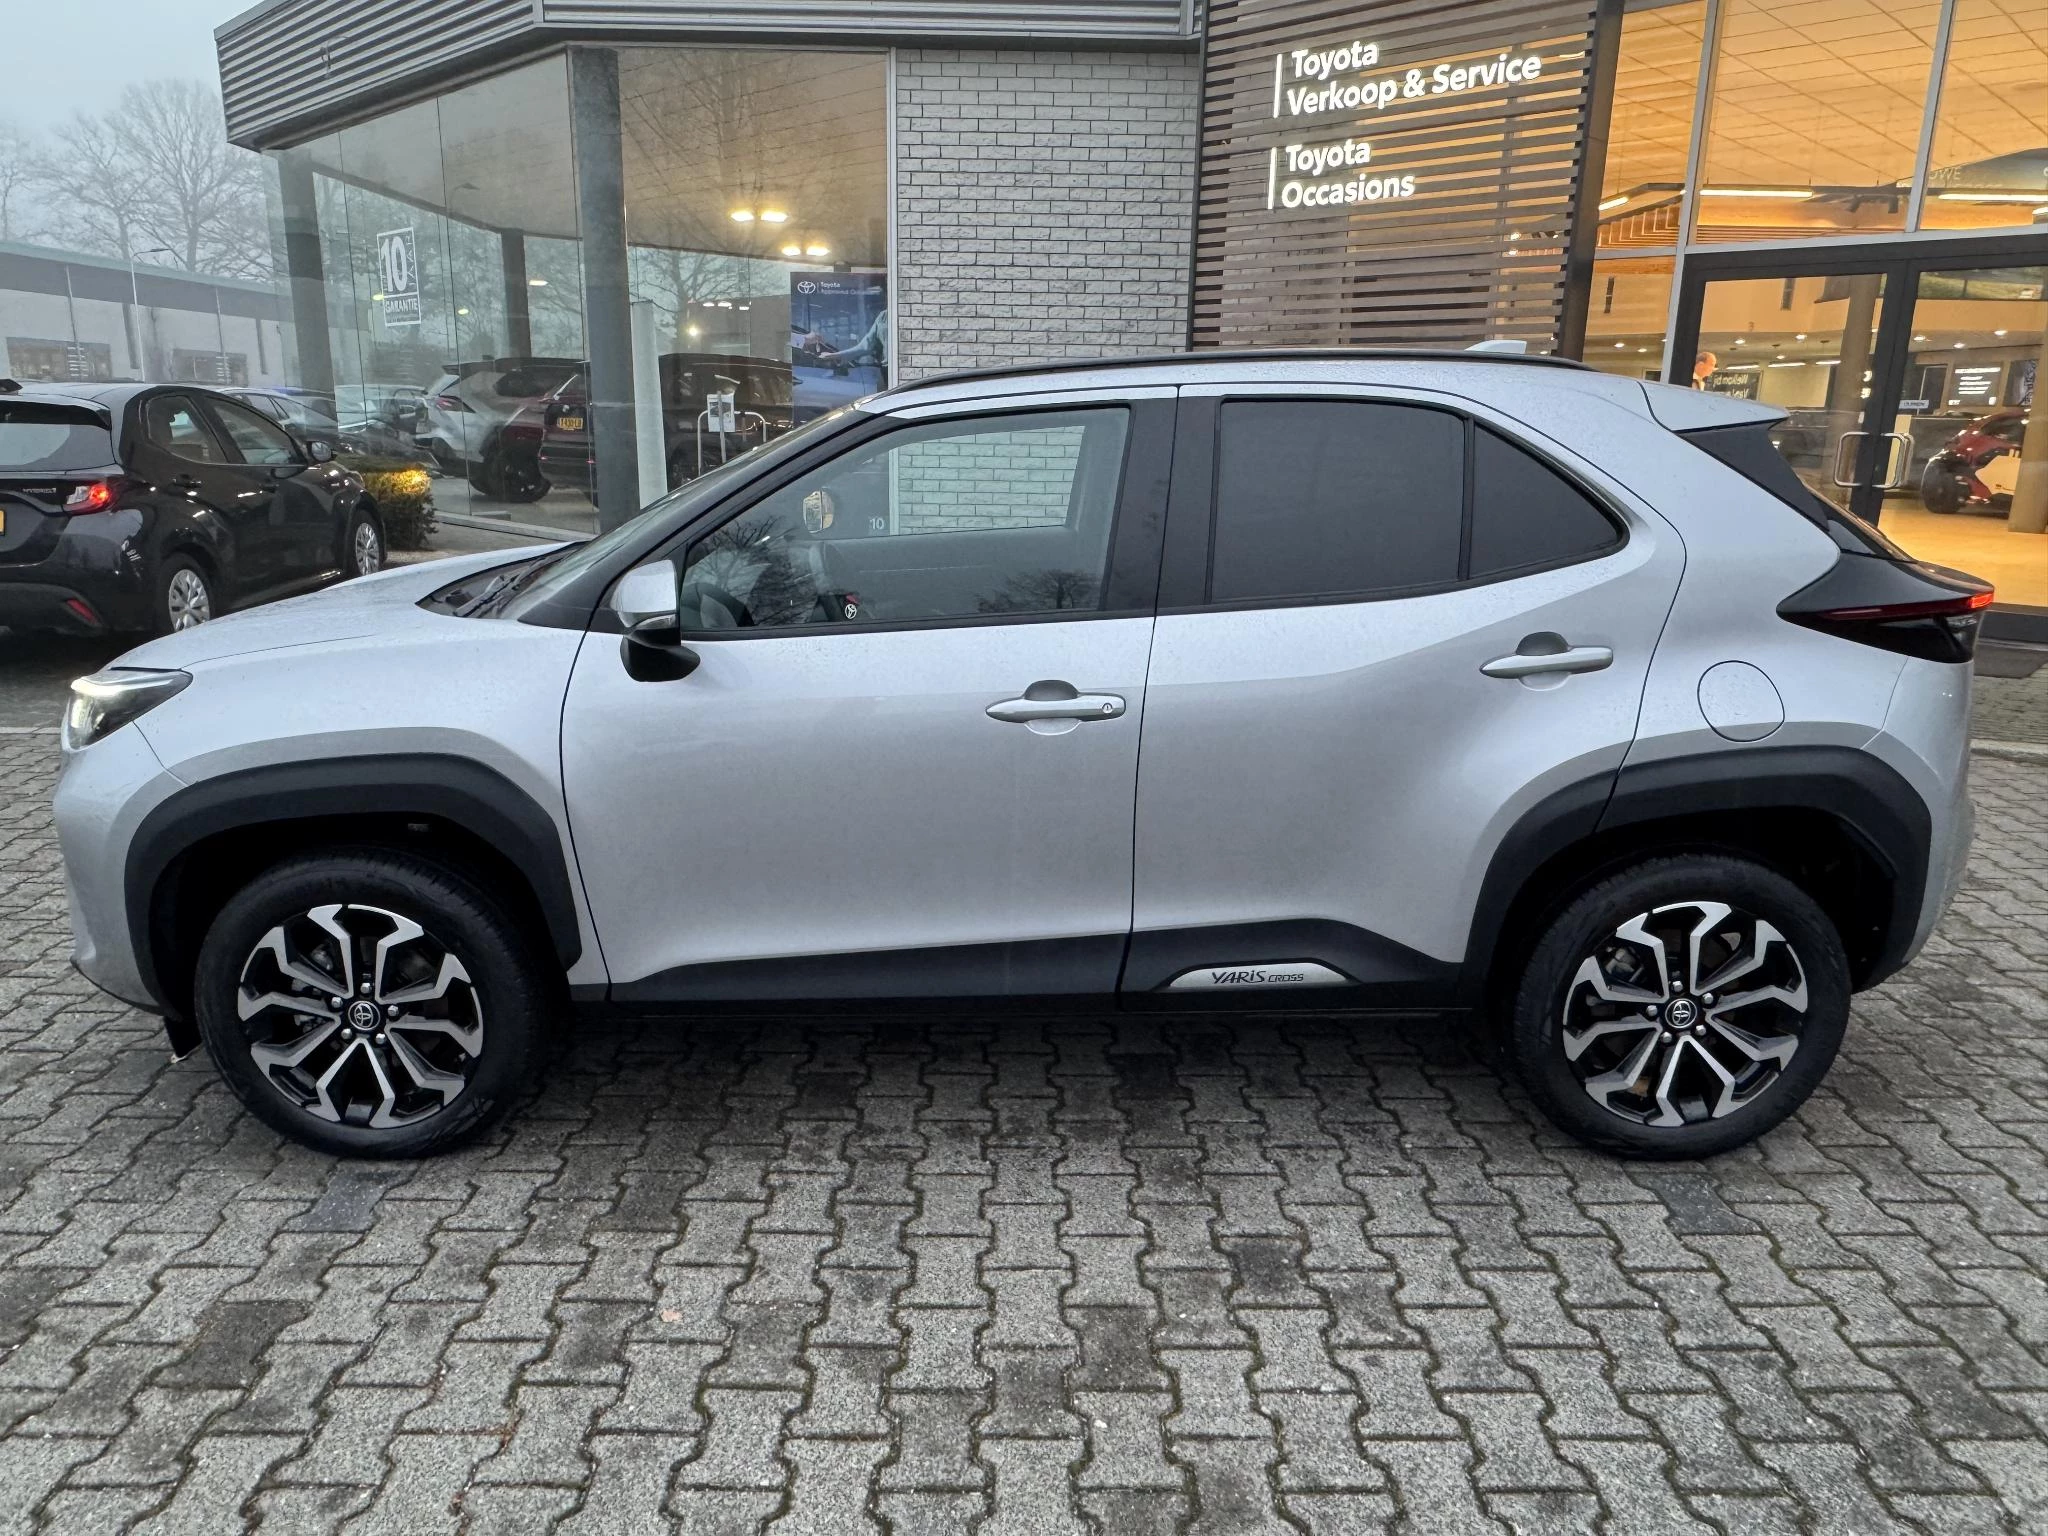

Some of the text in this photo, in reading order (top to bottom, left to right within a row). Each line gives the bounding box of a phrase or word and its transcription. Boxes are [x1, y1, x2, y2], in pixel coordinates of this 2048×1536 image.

[1292, 41, 1378, 80] Toyota
[1287, 54, 1541, 115] Verkoop & Service
[1286, 139, 1371, 176] Toyota
[1281, 173, 1415, 208] Occasions
[381, 236, 407, 292] 10
[820, 281, 840, 289] Toyota
[385, 299, 418, 313] GARANTIE
[869, 517, 885, 530] 10
[1212, 970, 1304, 984] YARIS CROSS
